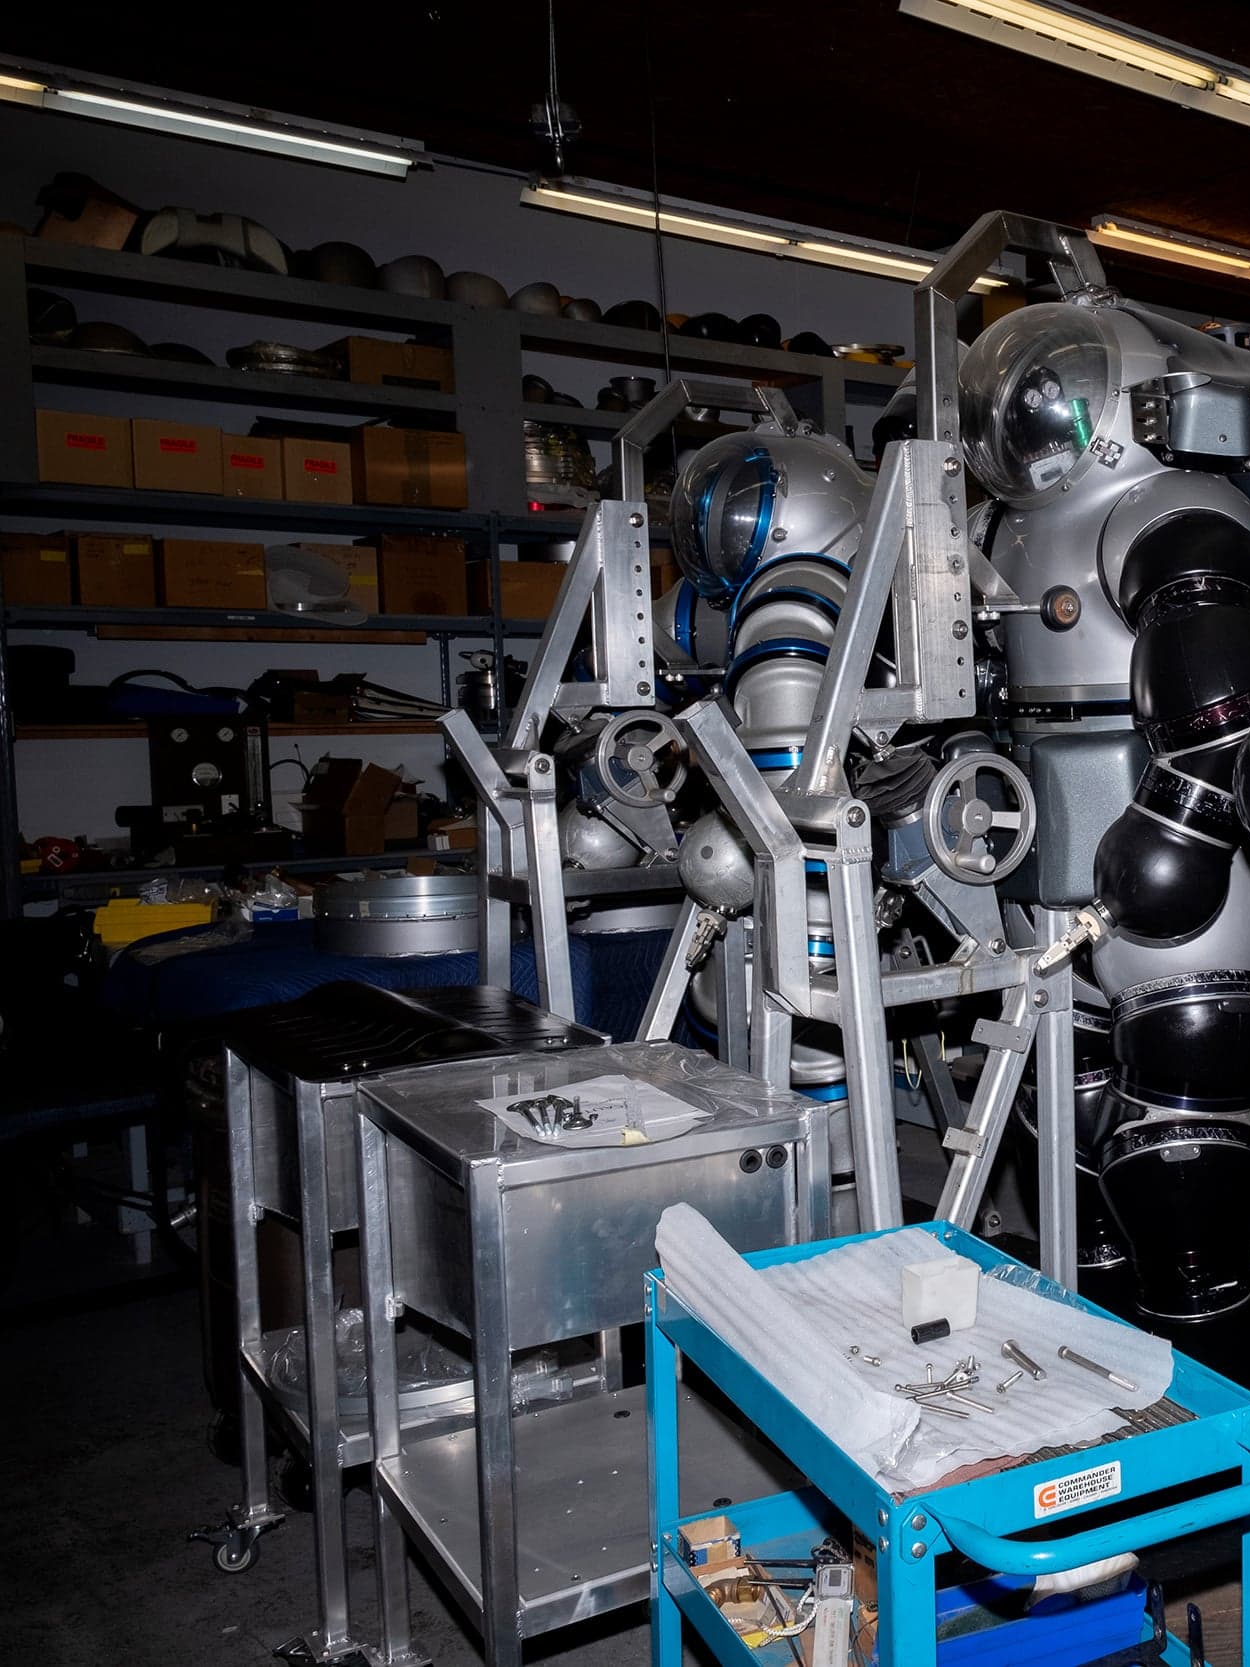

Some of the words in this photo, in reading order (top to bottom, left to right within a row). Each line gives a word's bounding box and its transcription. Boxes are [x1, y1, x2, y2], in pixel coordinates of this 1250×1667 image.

[1058, 1466, 1116, 1489] COMMANDER
[1058, 1474, 1113, 1496] WAREHOUSE
[1058, 1481, 1111, 1503] EQUIPMENT
